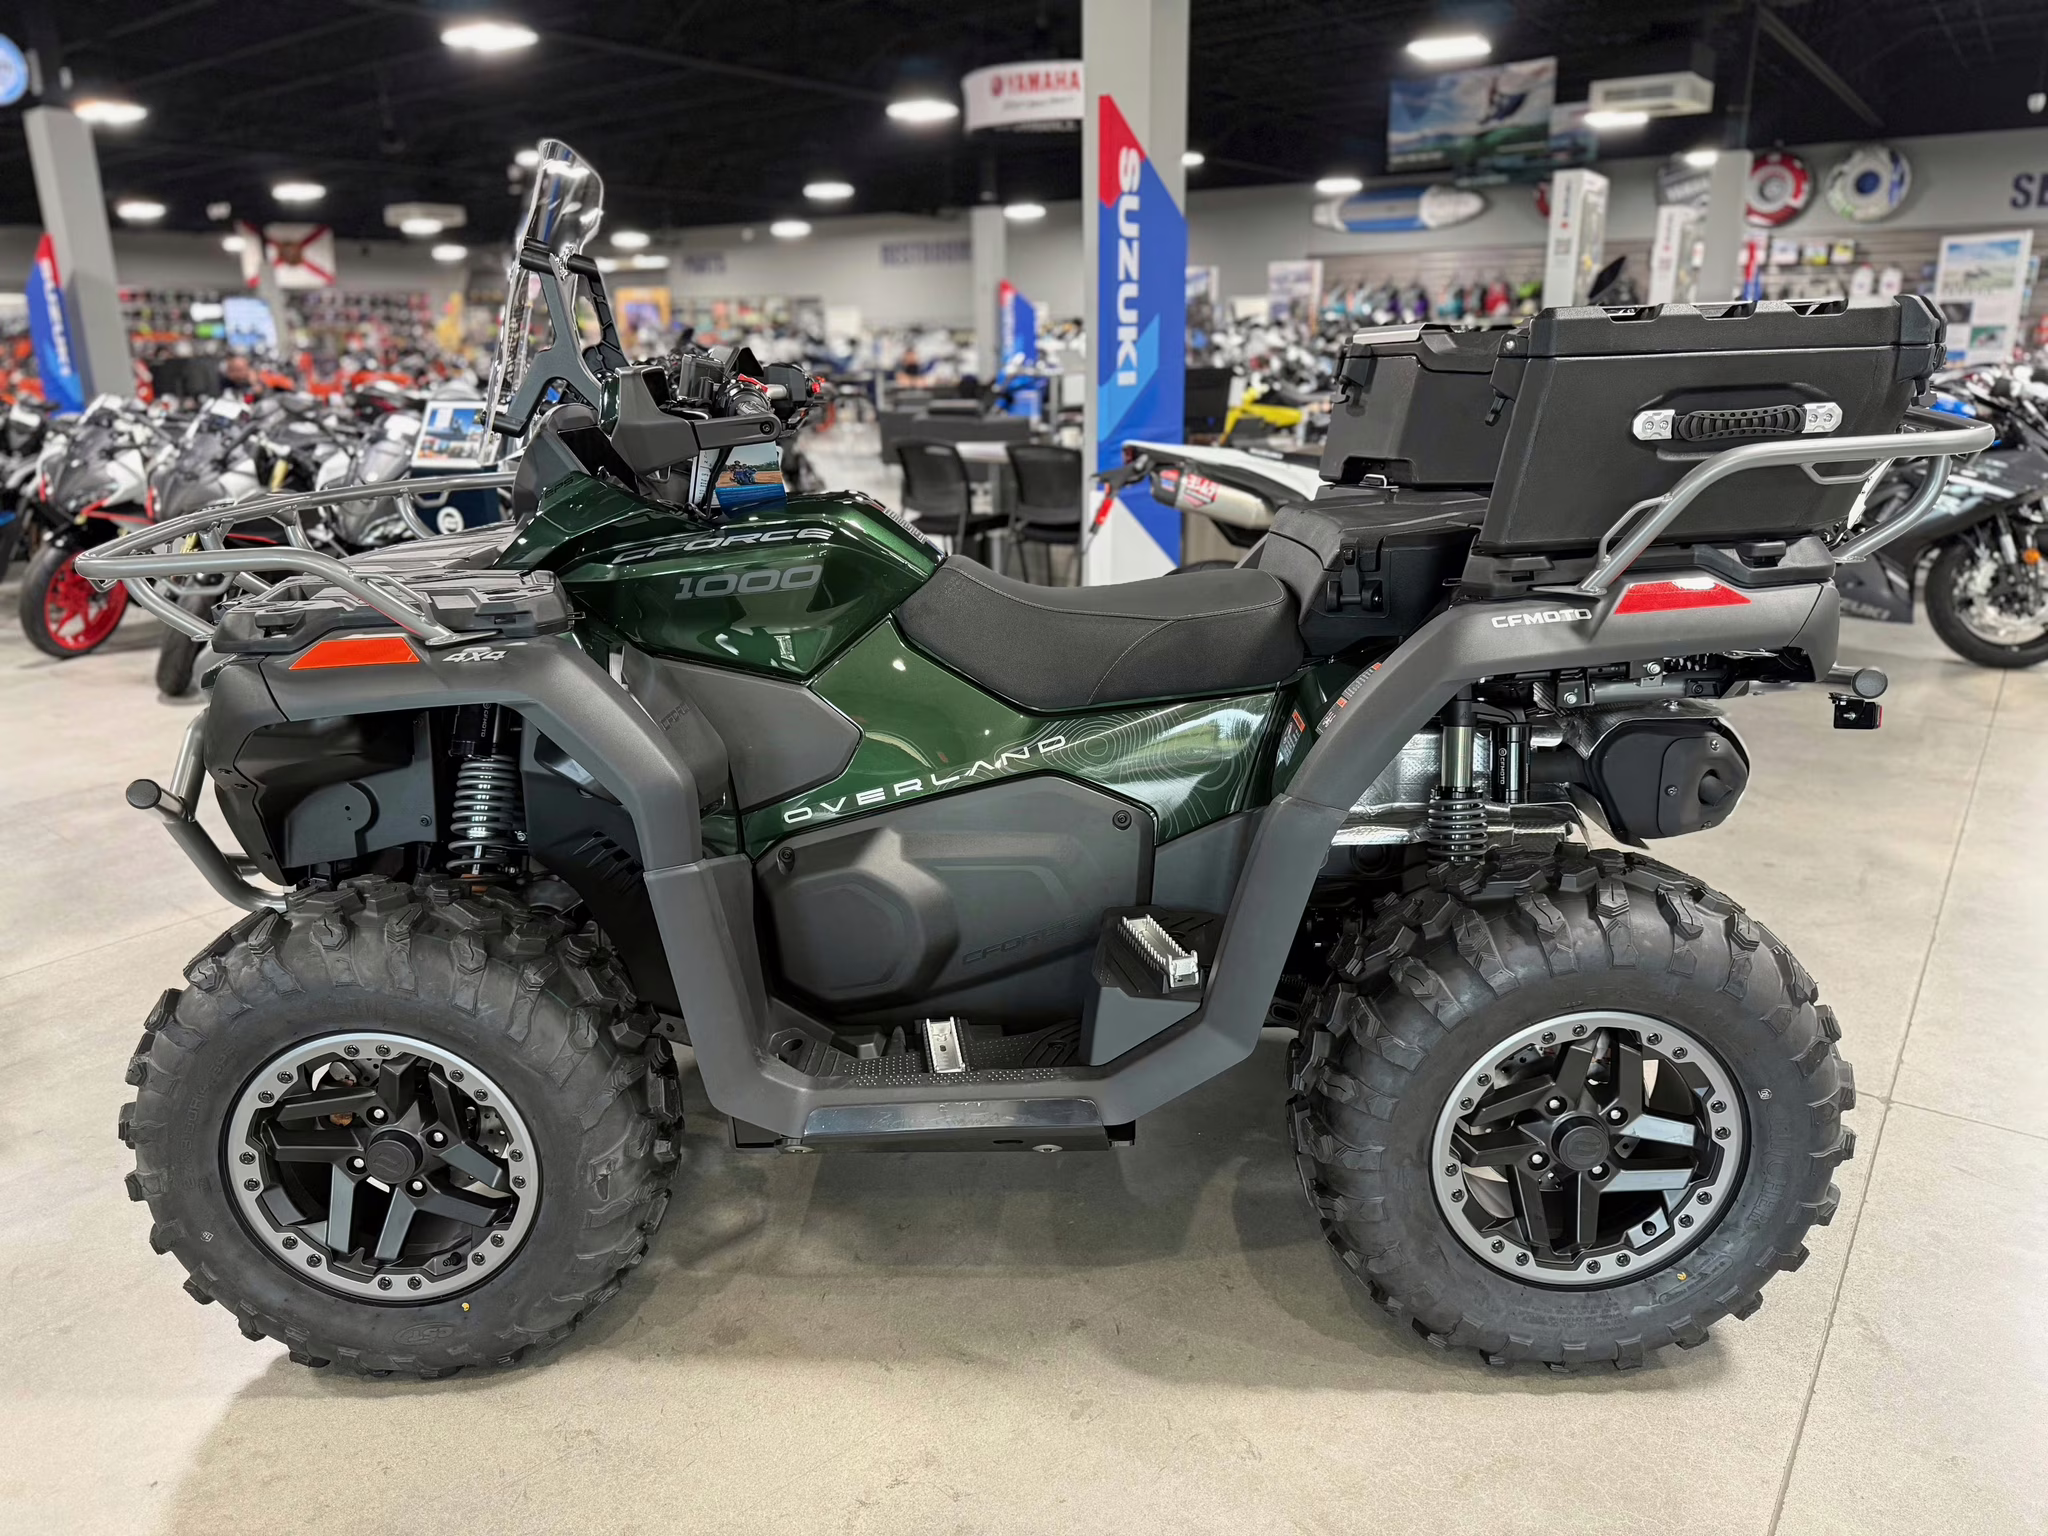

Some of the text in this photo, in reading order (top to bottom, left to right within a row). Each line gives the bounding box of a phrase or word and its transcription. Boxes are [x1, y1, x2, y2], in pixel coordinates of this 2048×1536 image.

[1117, 146, 1141, 387] SUZUKI
[544, 475, 575, 499] EPS
[612, 527, 835, 565] CFORCE
[674, 563, 824, 602] 1000
[1490, 607, 1593, 629] CFMOTO
[480, 709, 489, 738] CFMOTO
[782, 734, 1068, 826] OVERLAND
[960, 912, 1083, 966] CFORCE
